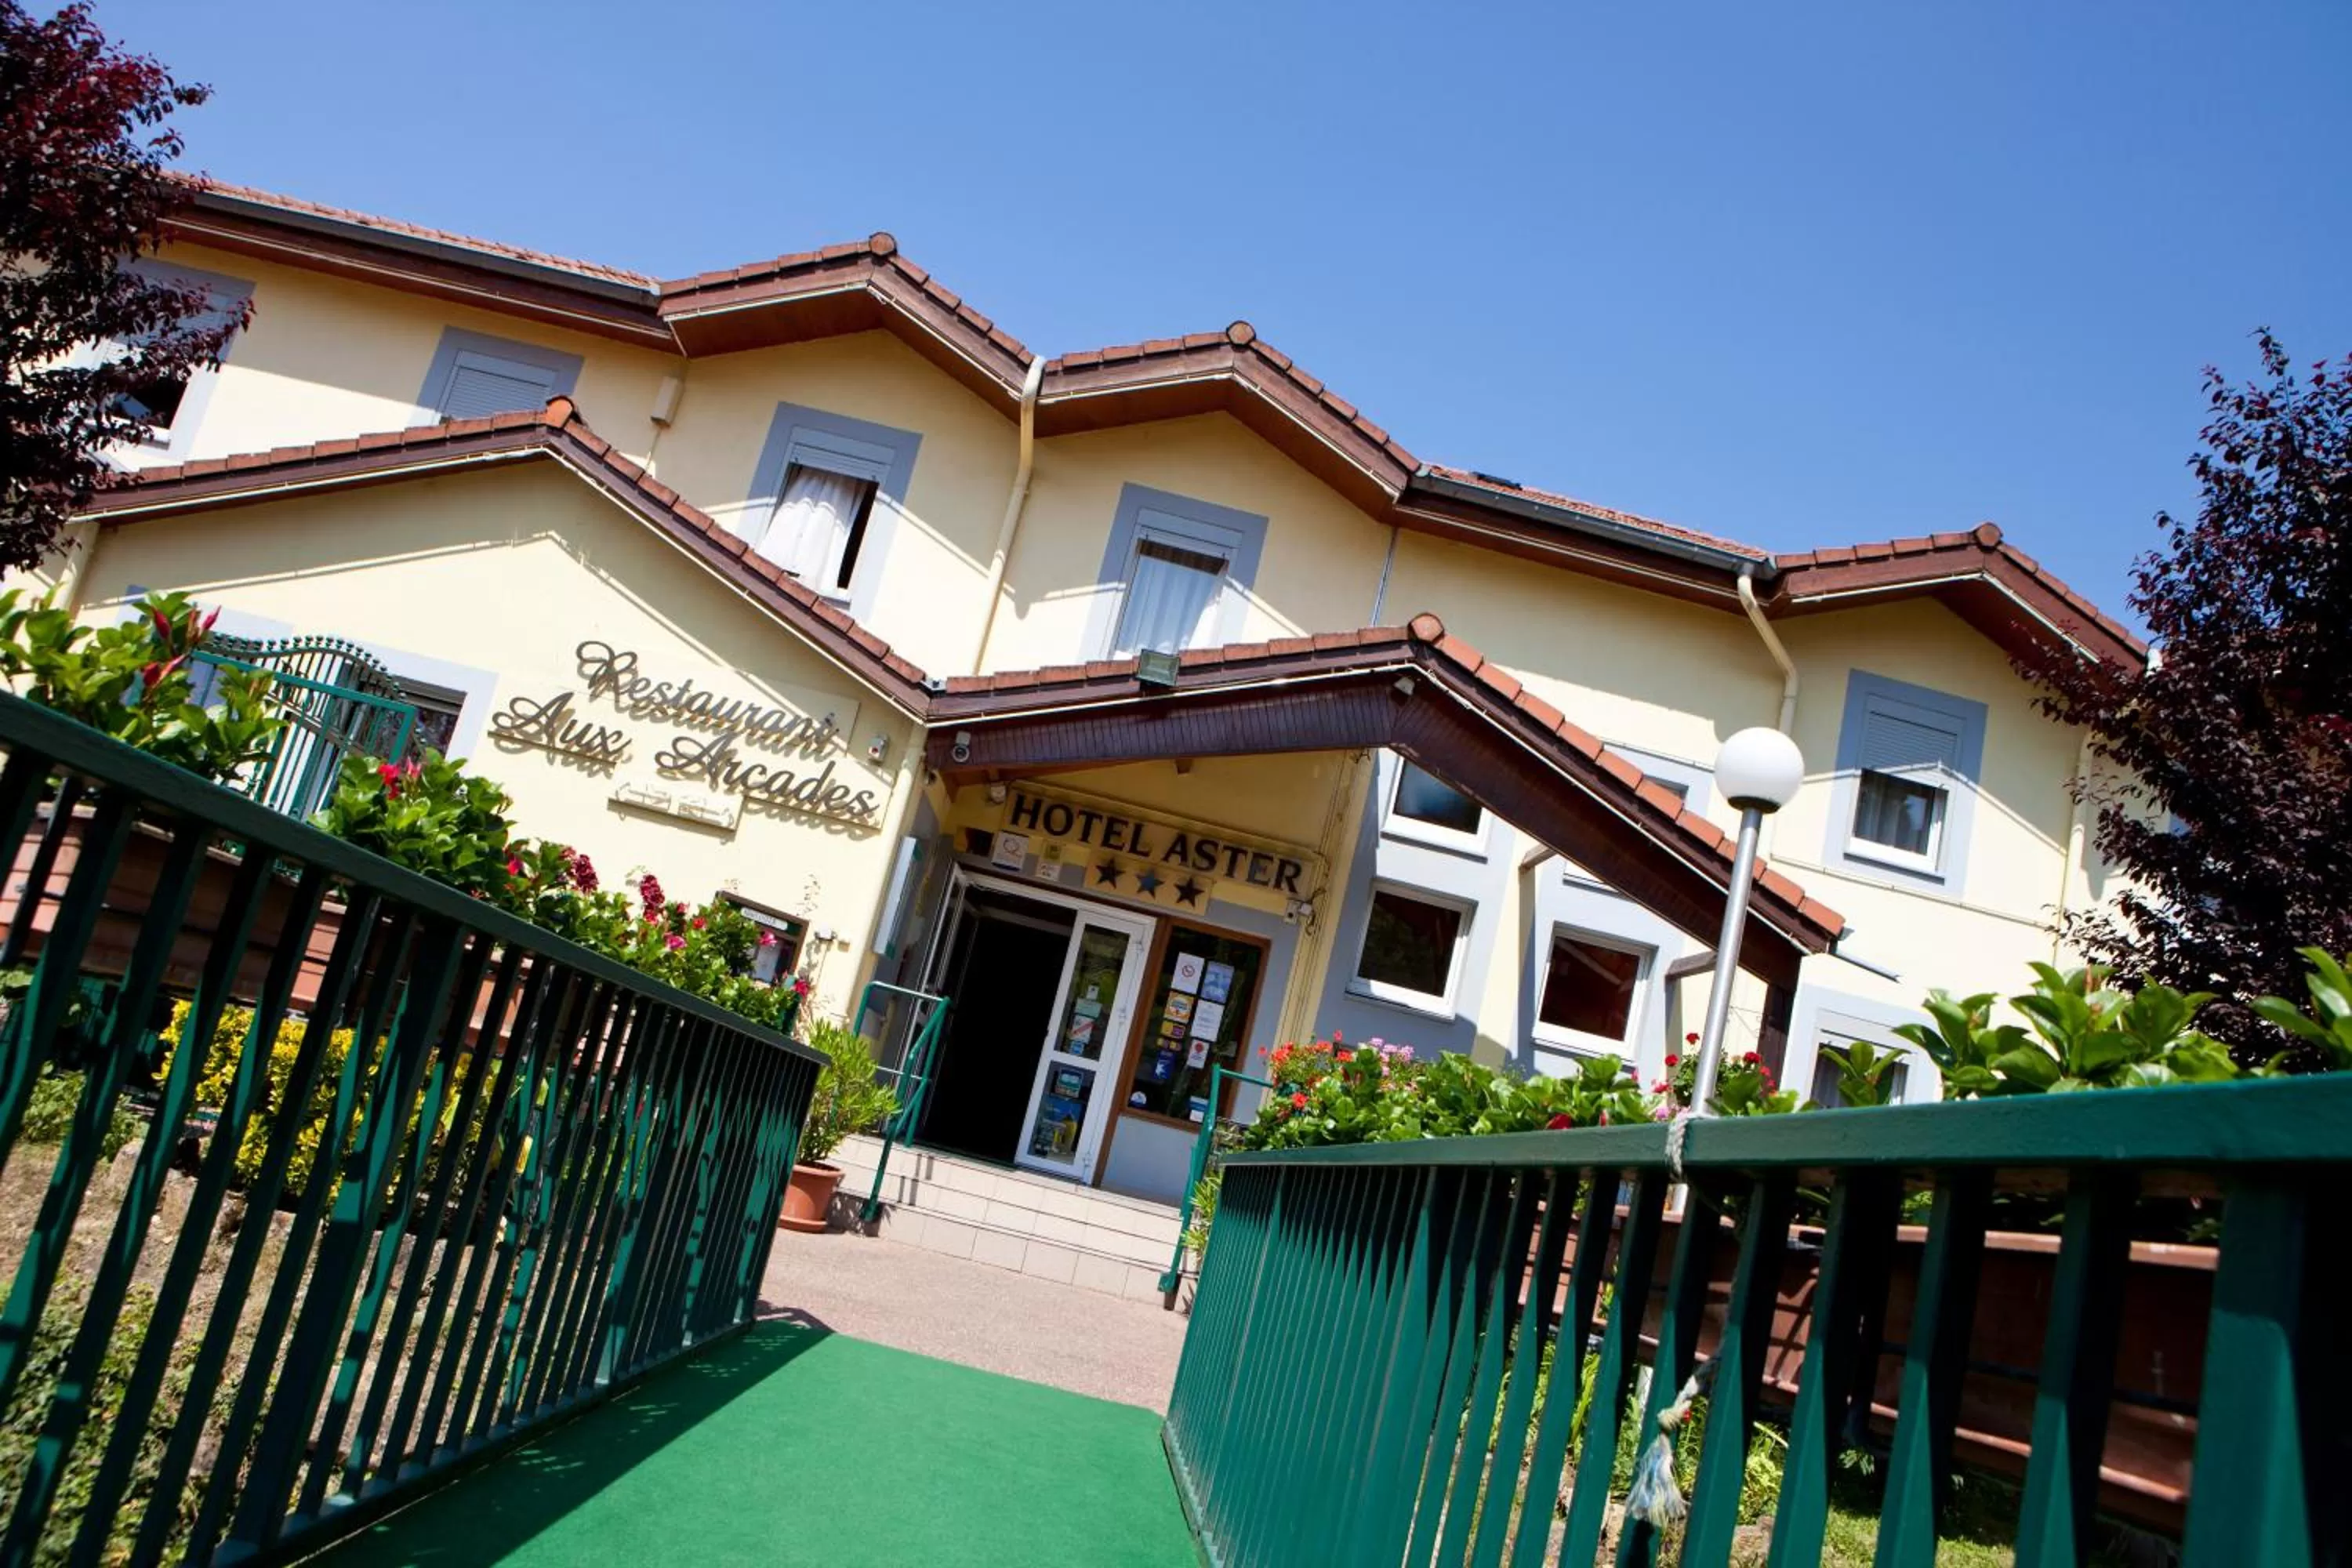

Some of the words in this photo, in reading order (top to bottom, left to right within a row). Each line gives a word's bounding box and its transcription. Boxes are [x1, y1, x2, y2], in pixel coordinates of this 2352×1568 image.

[575, 641, 838, 744] Restaurant
[492, 691, 632, 755] Aux
[654, 730, 880, 818] Arcades
[1011, 793, 1152, 857] HOTEL
[1162, 833, 1302, 894] ASTER
